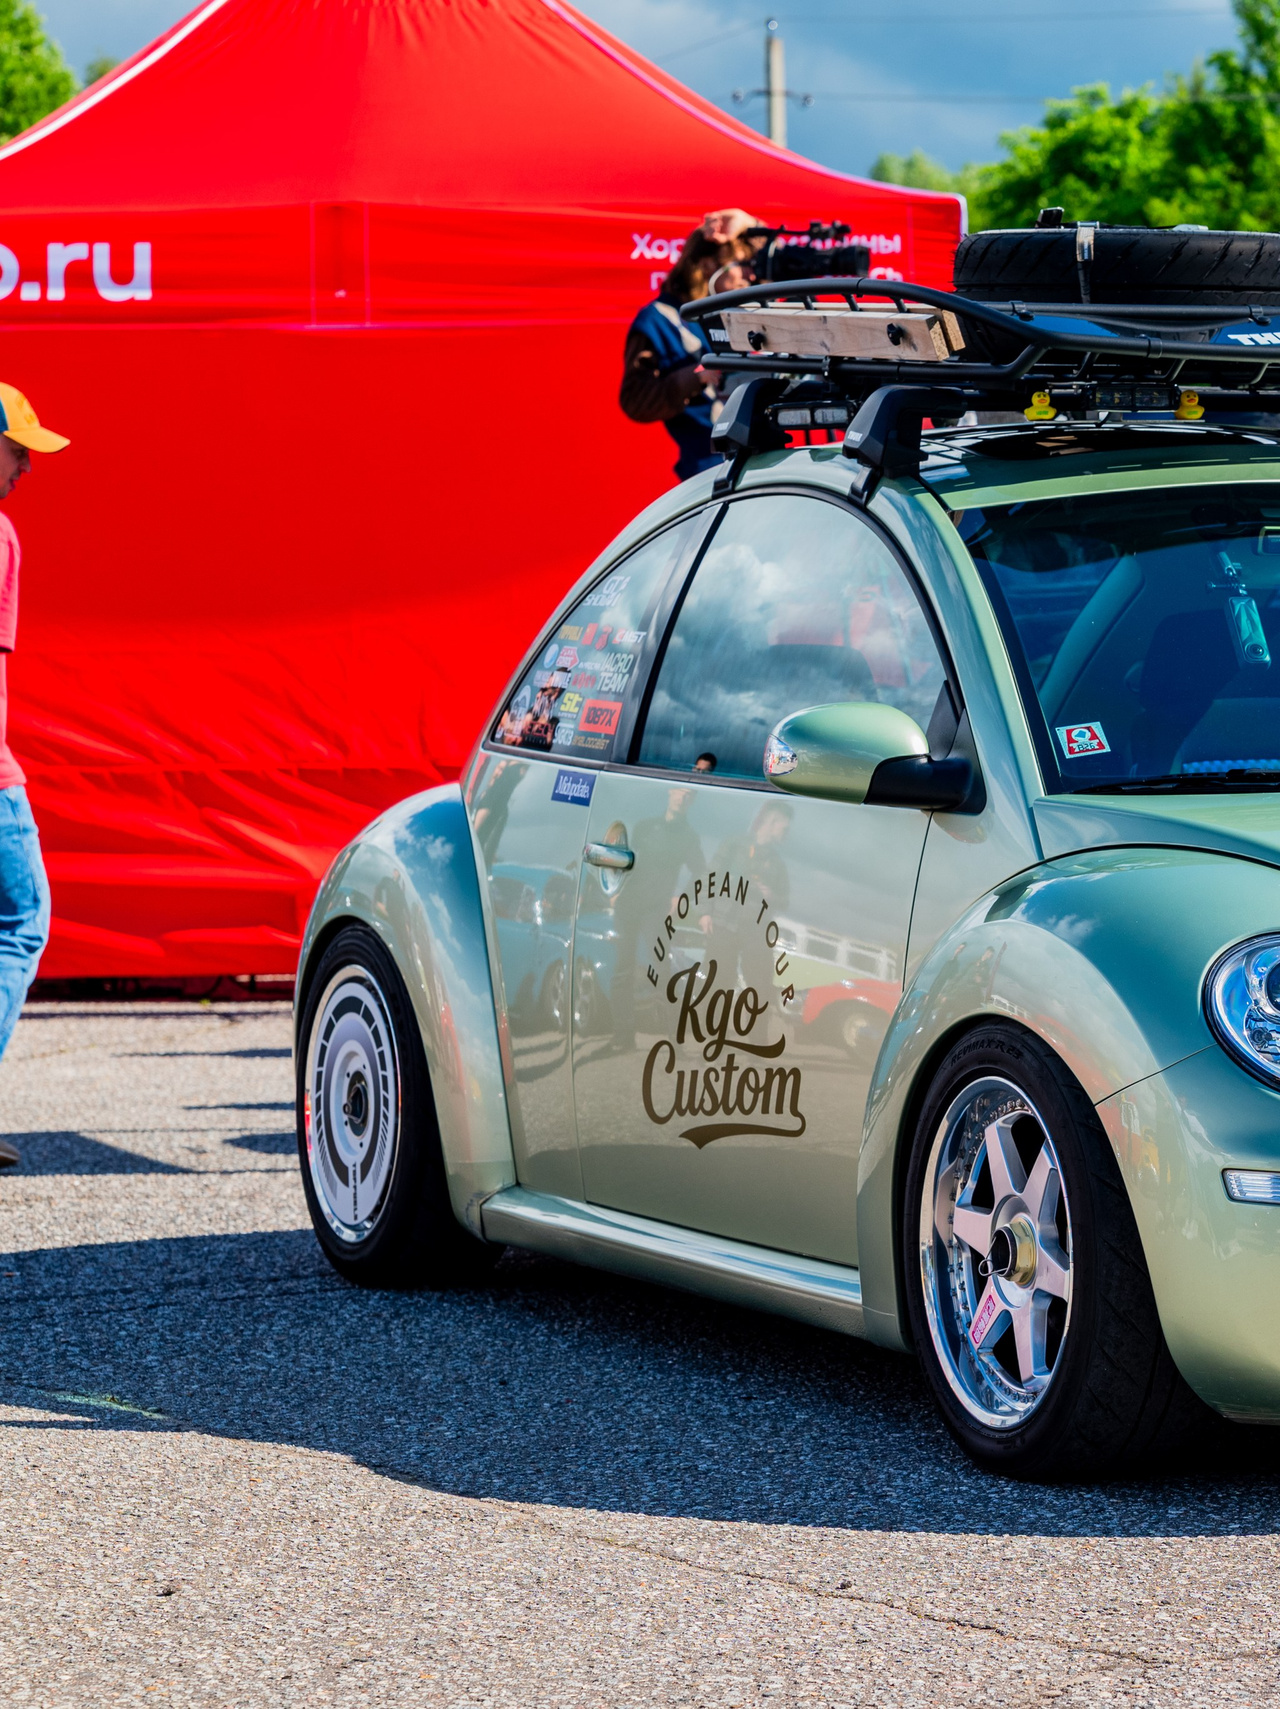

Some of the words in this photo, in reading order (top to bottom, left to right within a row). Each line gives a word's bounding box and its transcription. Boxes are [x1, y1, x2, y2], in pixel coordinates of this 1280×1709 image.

[597, 671, 629, 693] TEAM
[646, 871, 749, 987] EUROPEAN
[756, 898, 795, 1007] TOUR
[666, 959, 786, 1062] Kgo
[641, 1039, 806, 1138] Custom
